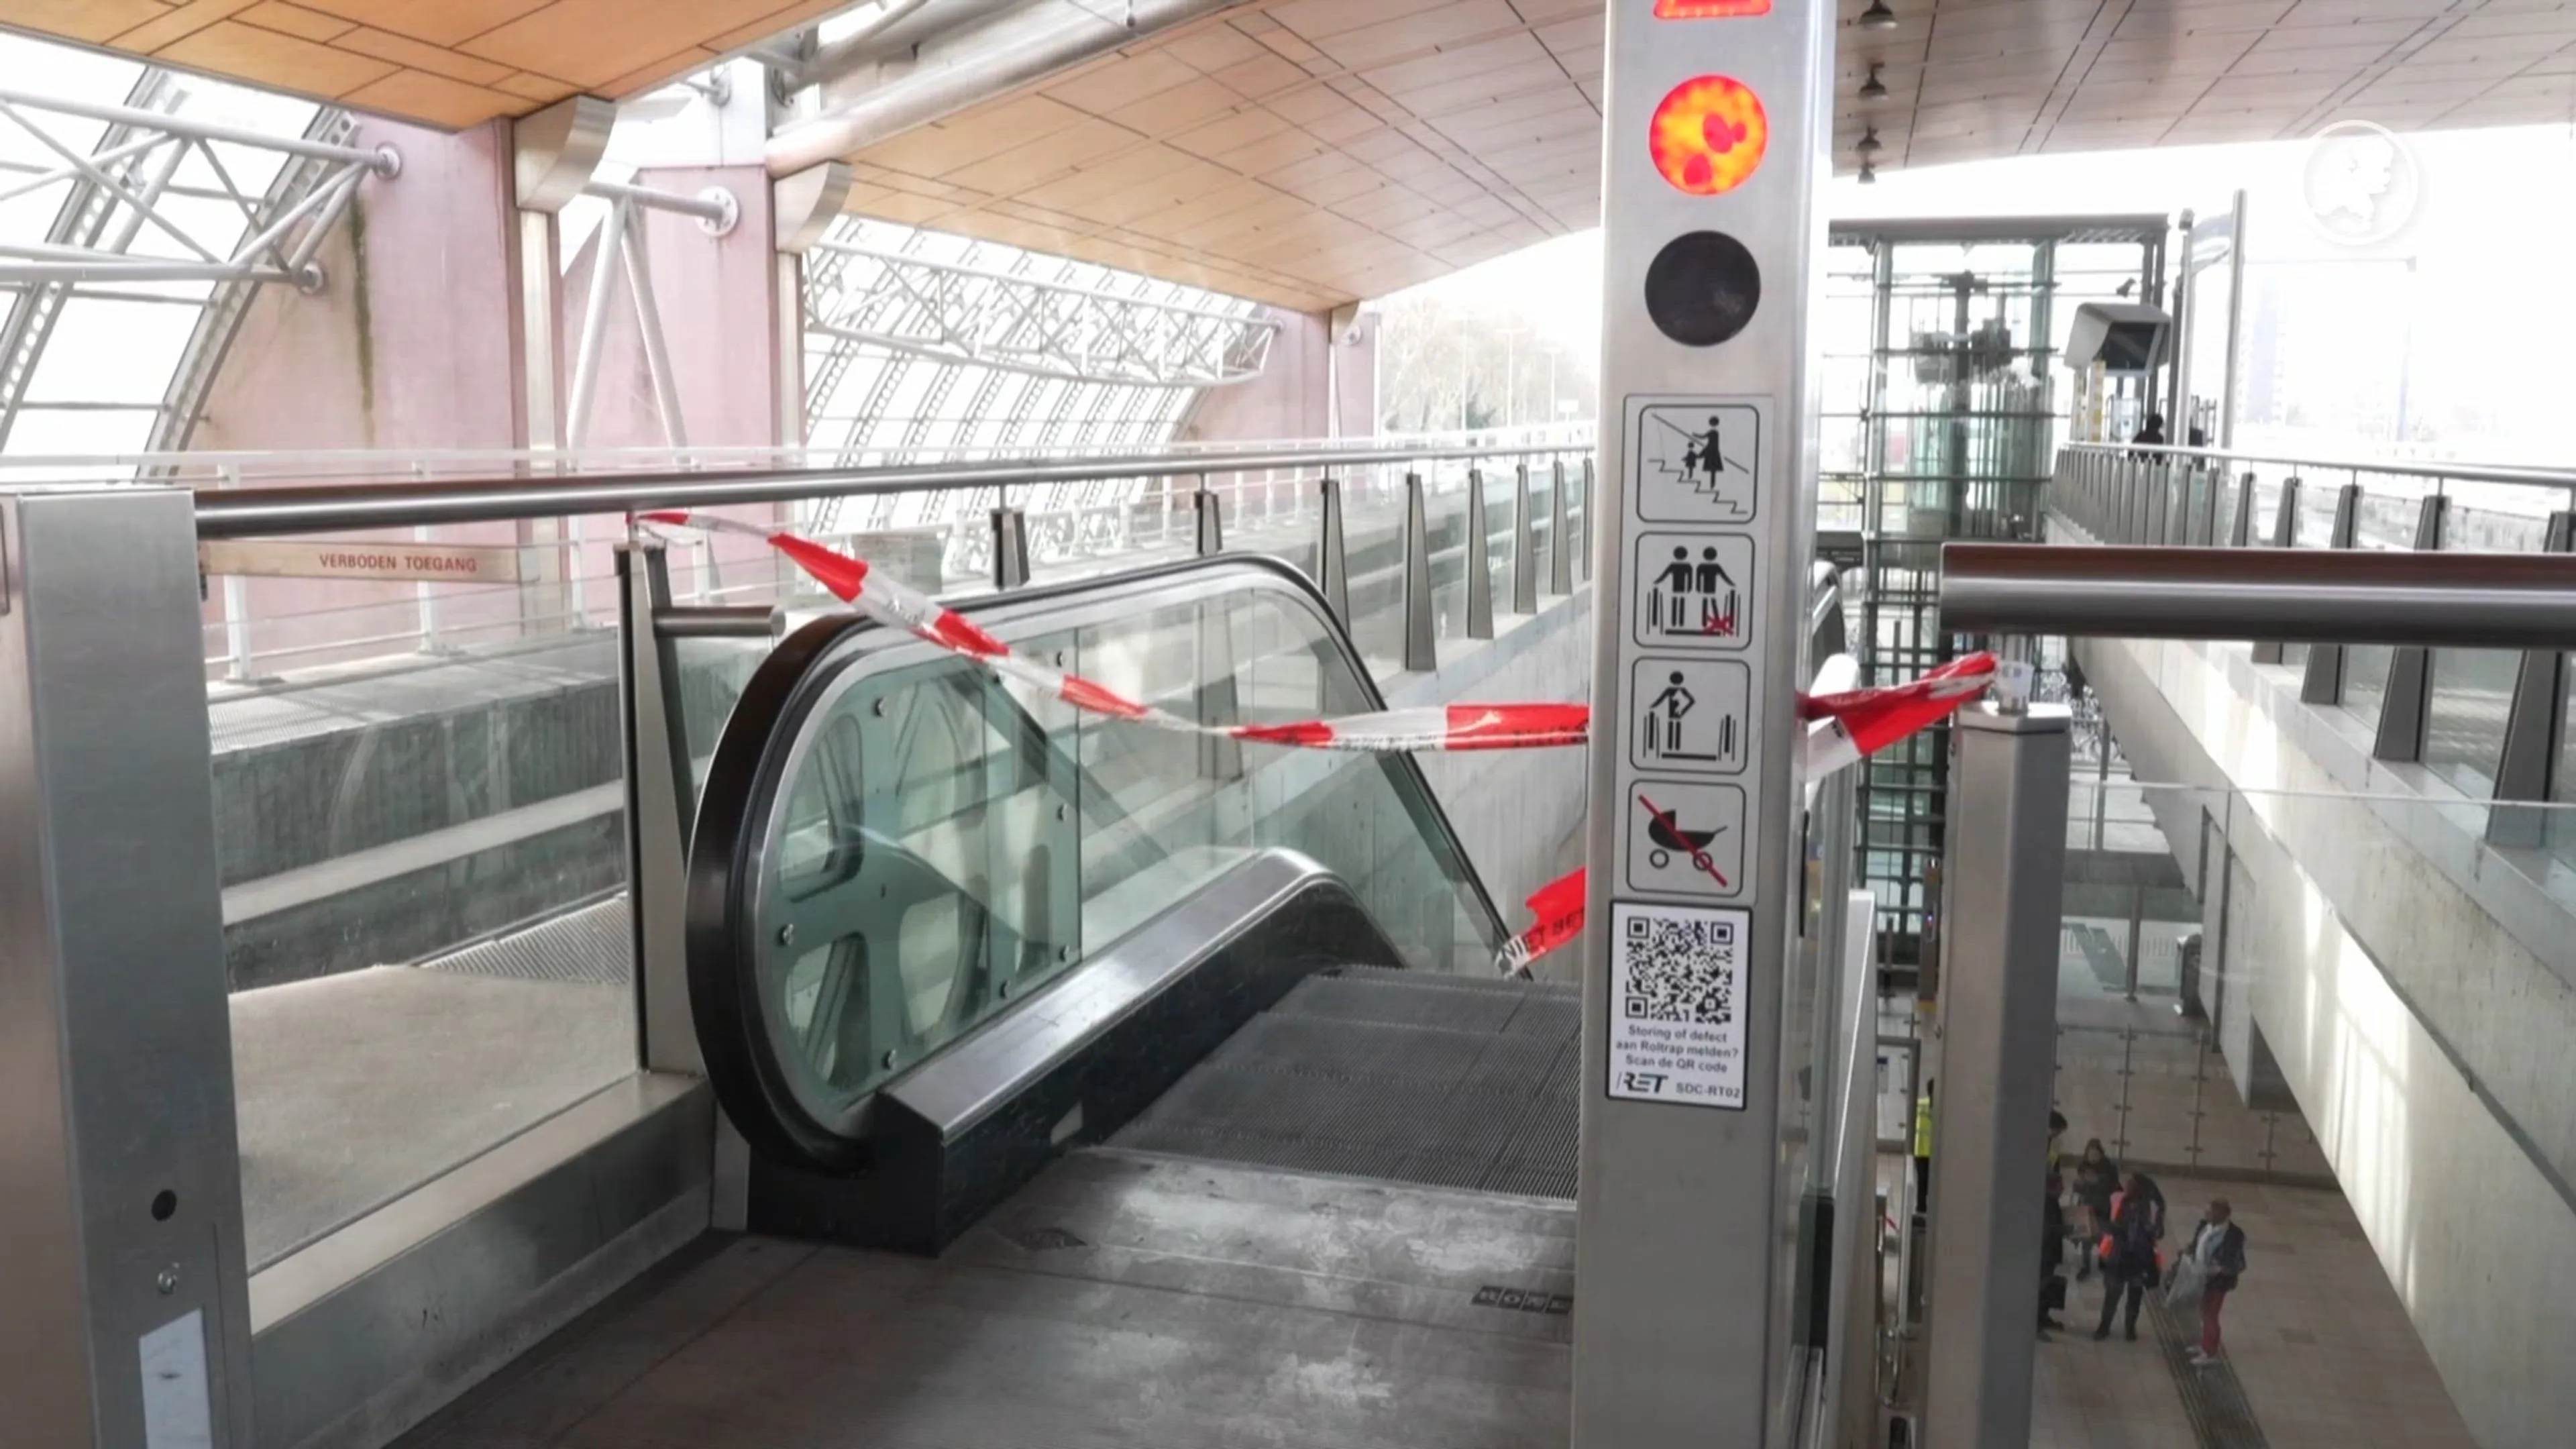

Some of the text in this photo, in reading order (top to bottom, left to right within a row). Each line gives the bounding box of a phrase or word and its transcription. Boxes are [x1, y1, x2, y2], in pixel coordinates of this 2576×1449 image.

[319, 553, 478, 572] VERBODEN TOEGANG
[1628, 1024, 1727, 1042] Storing of defect
[1615, 1042, 1739, 1058] aan Roltrap melden?
[1625, 1055, 1727, 1073] Scan de QR code
[1623, 1072, 1741, 1098] RET SDC-RT02
